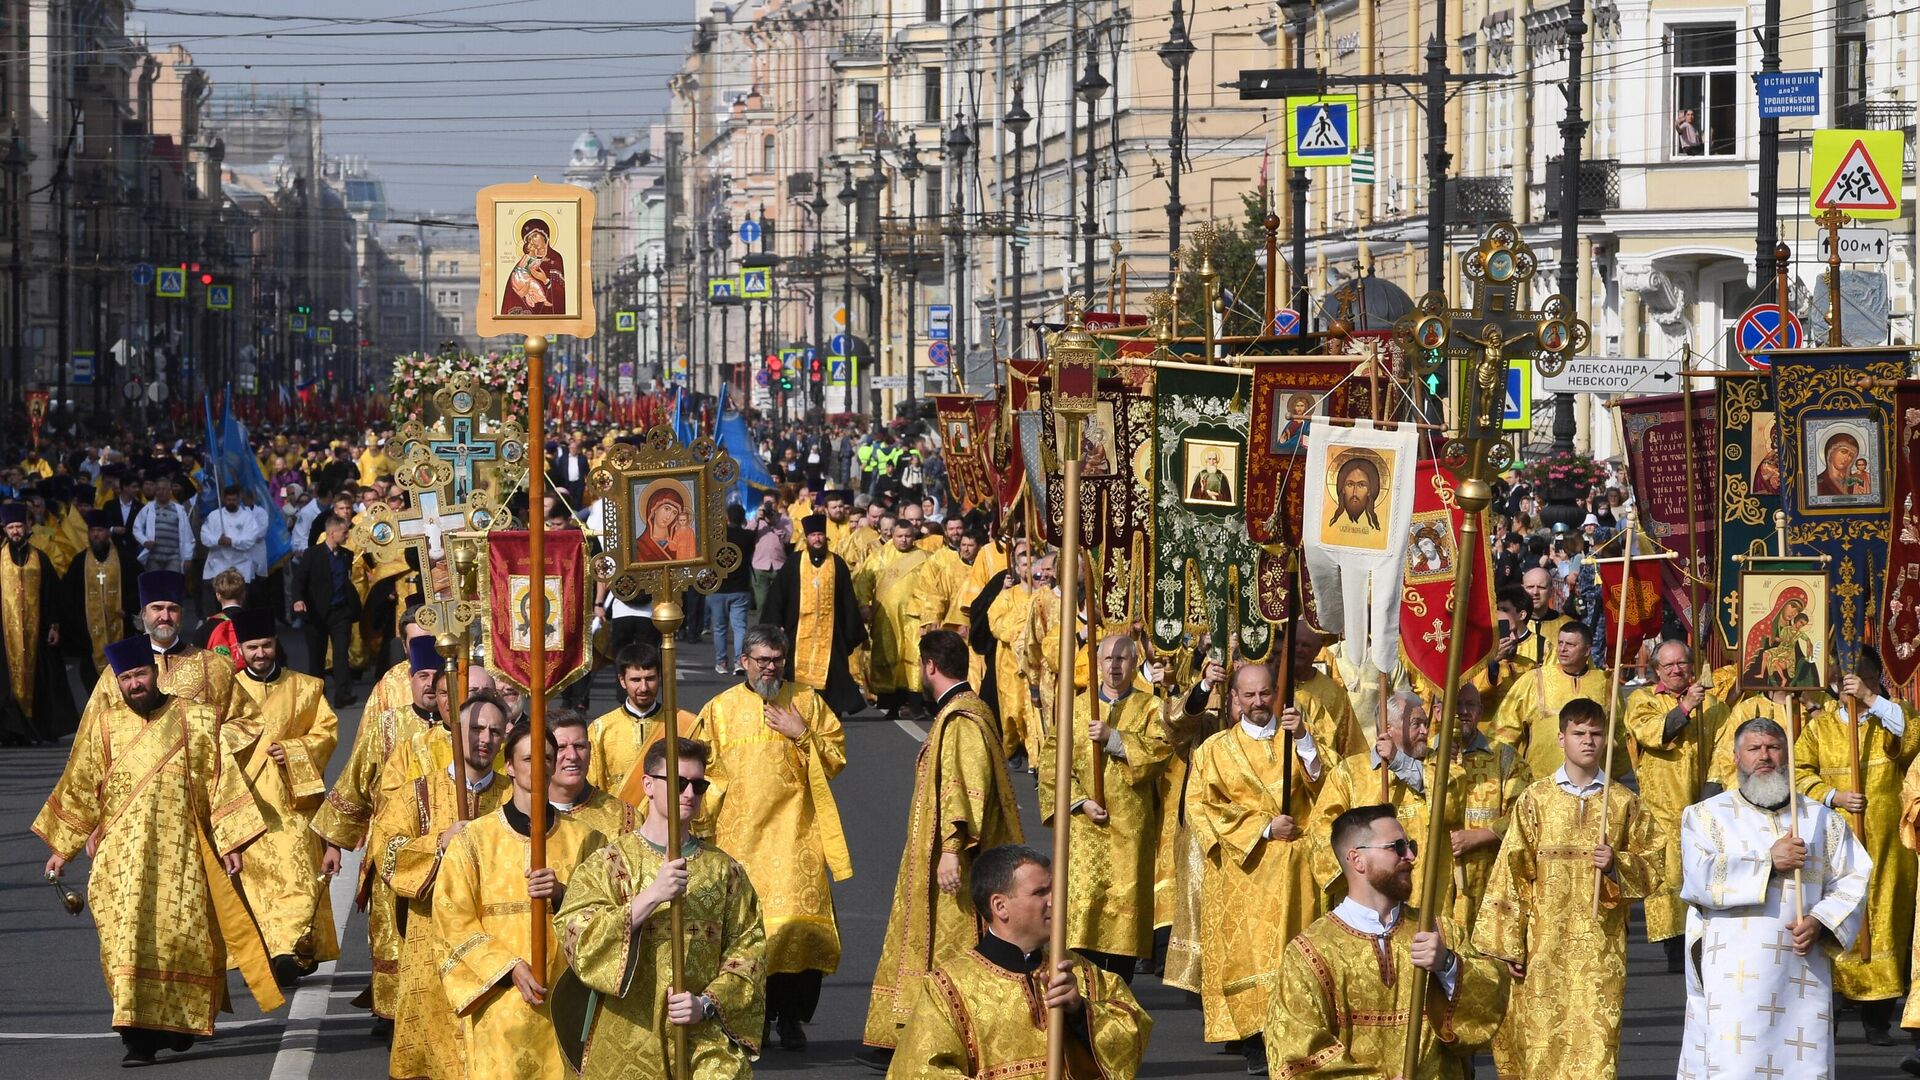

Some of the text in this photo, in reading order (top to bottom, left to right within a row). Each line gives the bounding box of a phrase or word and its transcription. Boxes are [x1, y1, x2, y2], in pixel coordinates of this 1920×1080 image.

[1764, 76, 1815, 86] ОСТАНОВКА
[1764, 95, 1815, 105] ТРОЛЛЕЙБУСОВ
[1764, 105, 1815, 113] ОДНОВРЕМЕННО
[1568, 364, 1648, 375] АЛЕКСАНДРА
[1568, 376, 1629, 386] НЕВСКОГО
